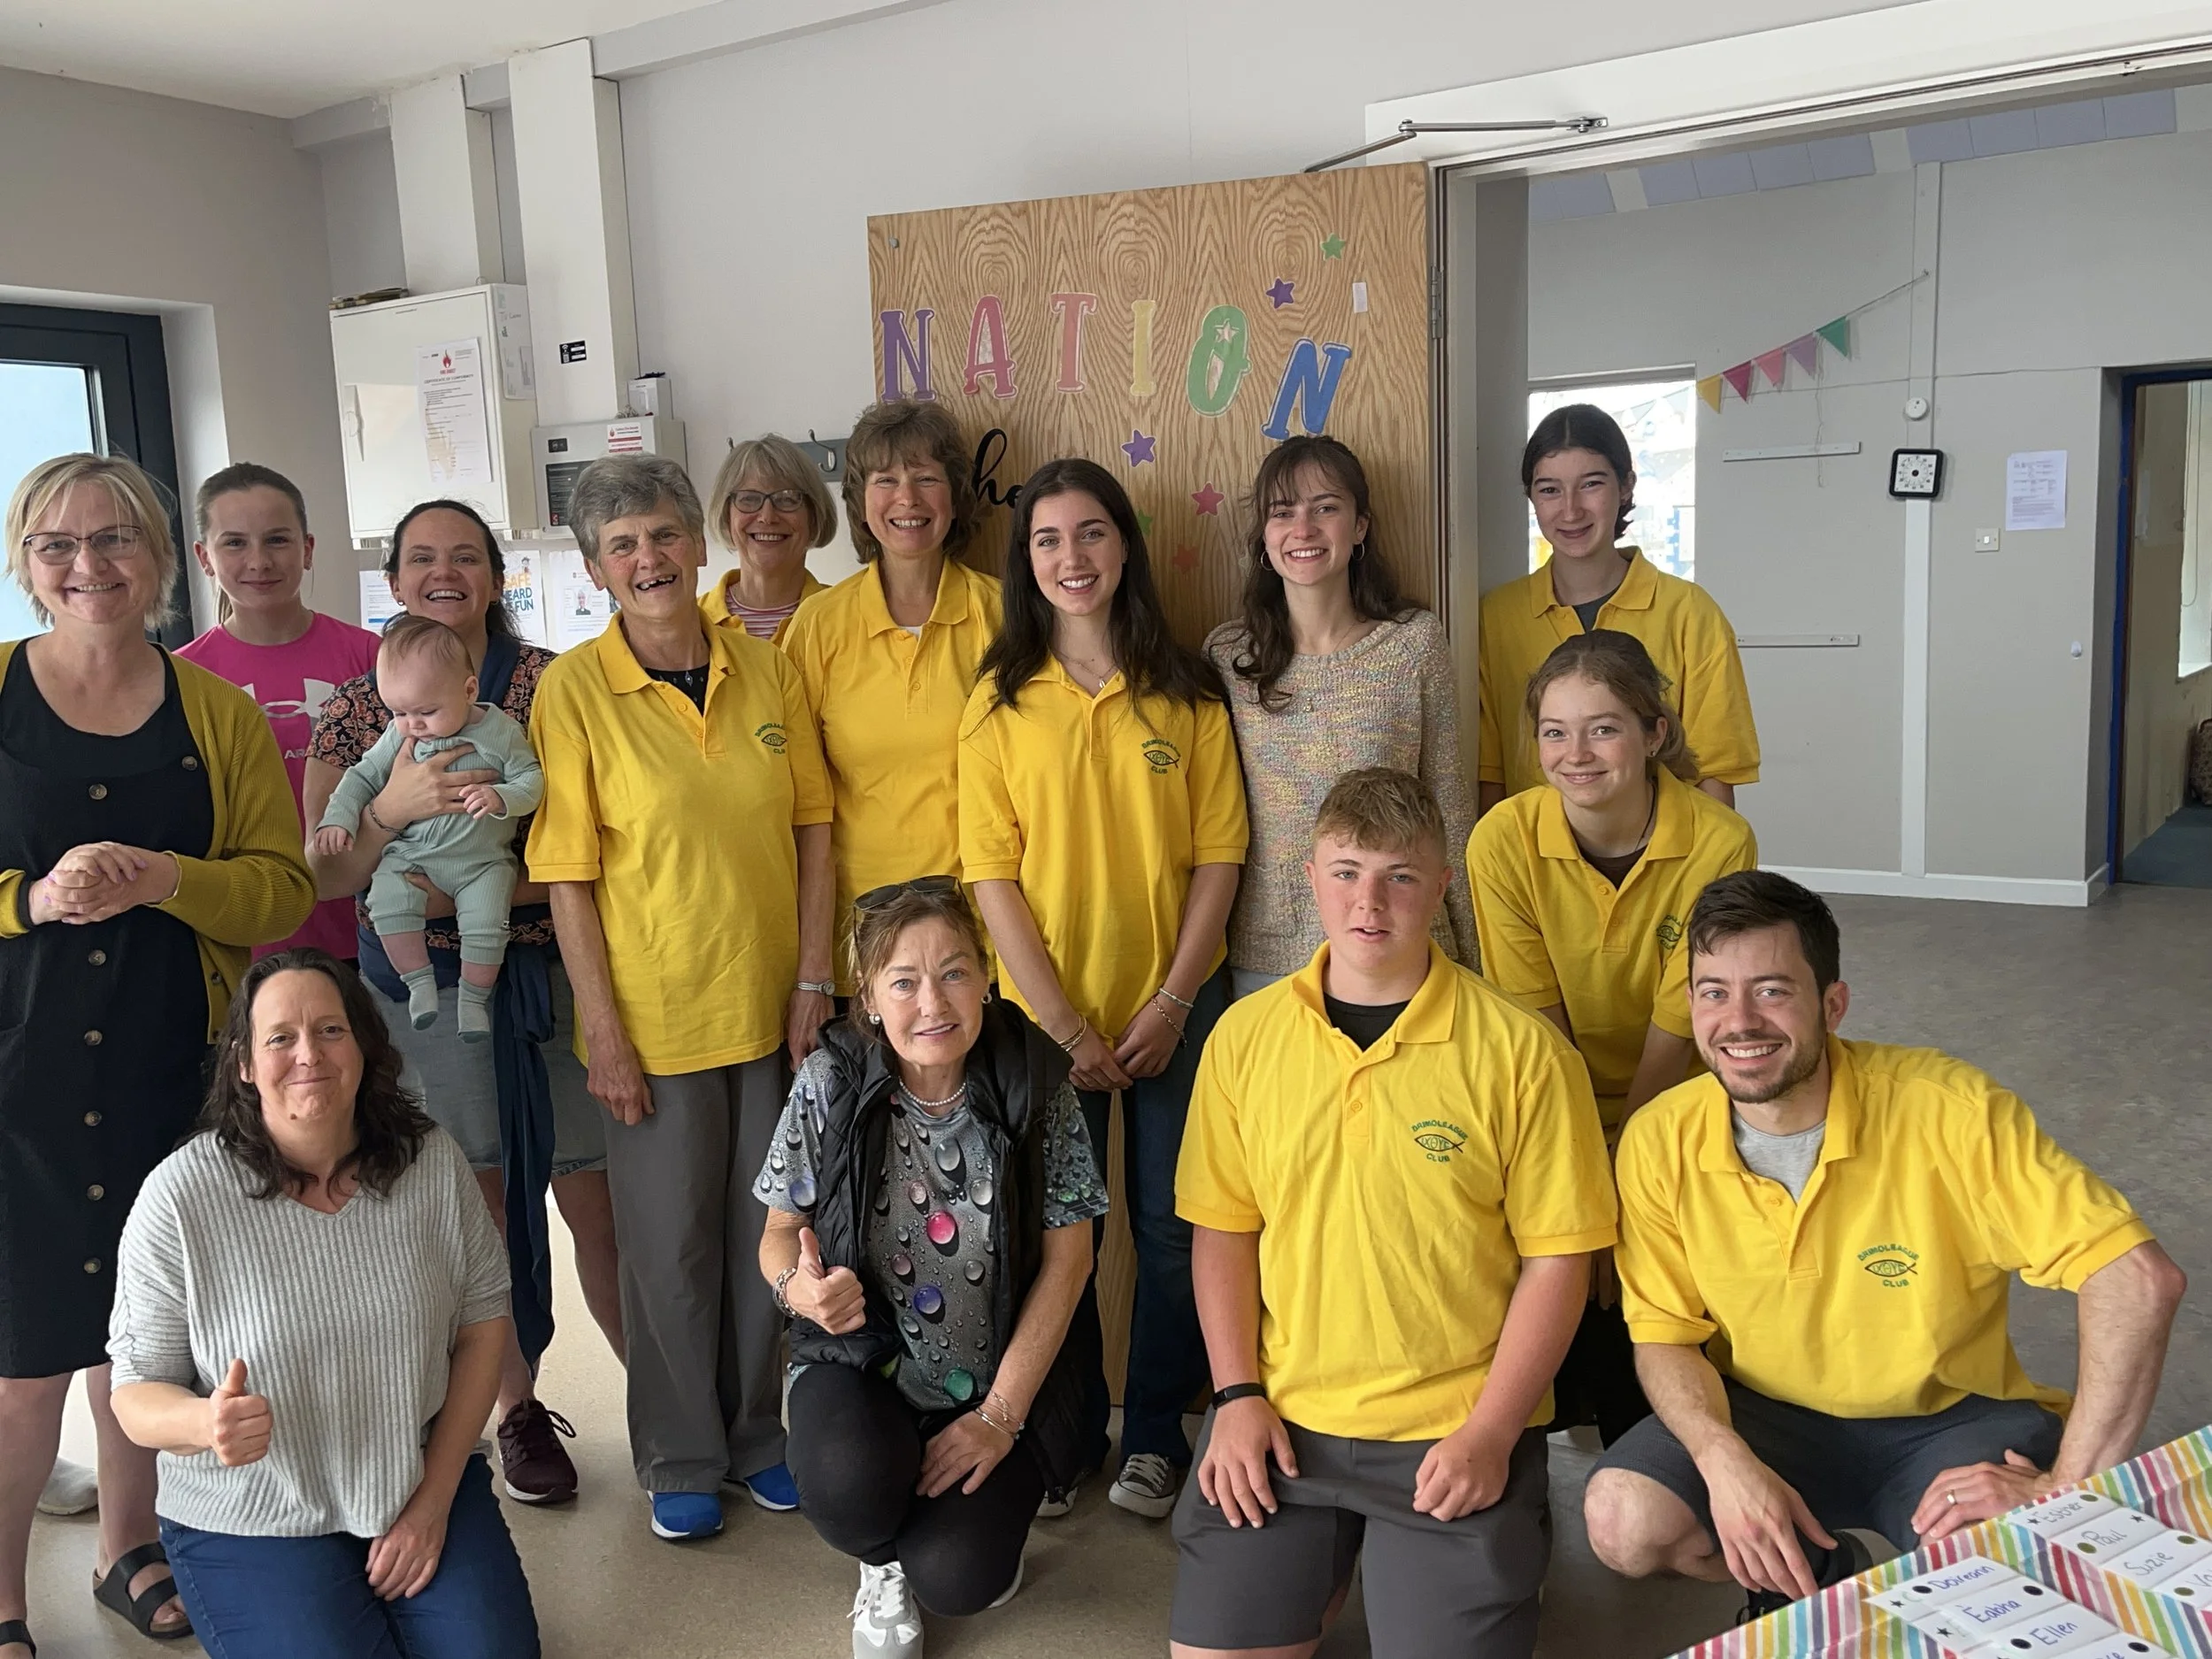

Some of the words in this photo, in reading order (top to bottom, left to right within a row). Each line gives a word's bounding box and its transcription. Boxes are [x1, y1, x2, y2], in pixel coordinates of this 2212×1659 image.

[880, 292, 1352, 441] NATION
[515, 599, 534, 612] FUN
[1411, 1119, 1469, 1141] DRIMOLEAGUE
[1426, 1153, 1450, 1163] CLUB
[1883, 1279, 1909, 1287] CLUB
[2081, 1529, 2127, 1547] Paul
[2124, 1551, 2174, 1576] Suzie
[2030, 1621, 2078, 1646] Ellen
